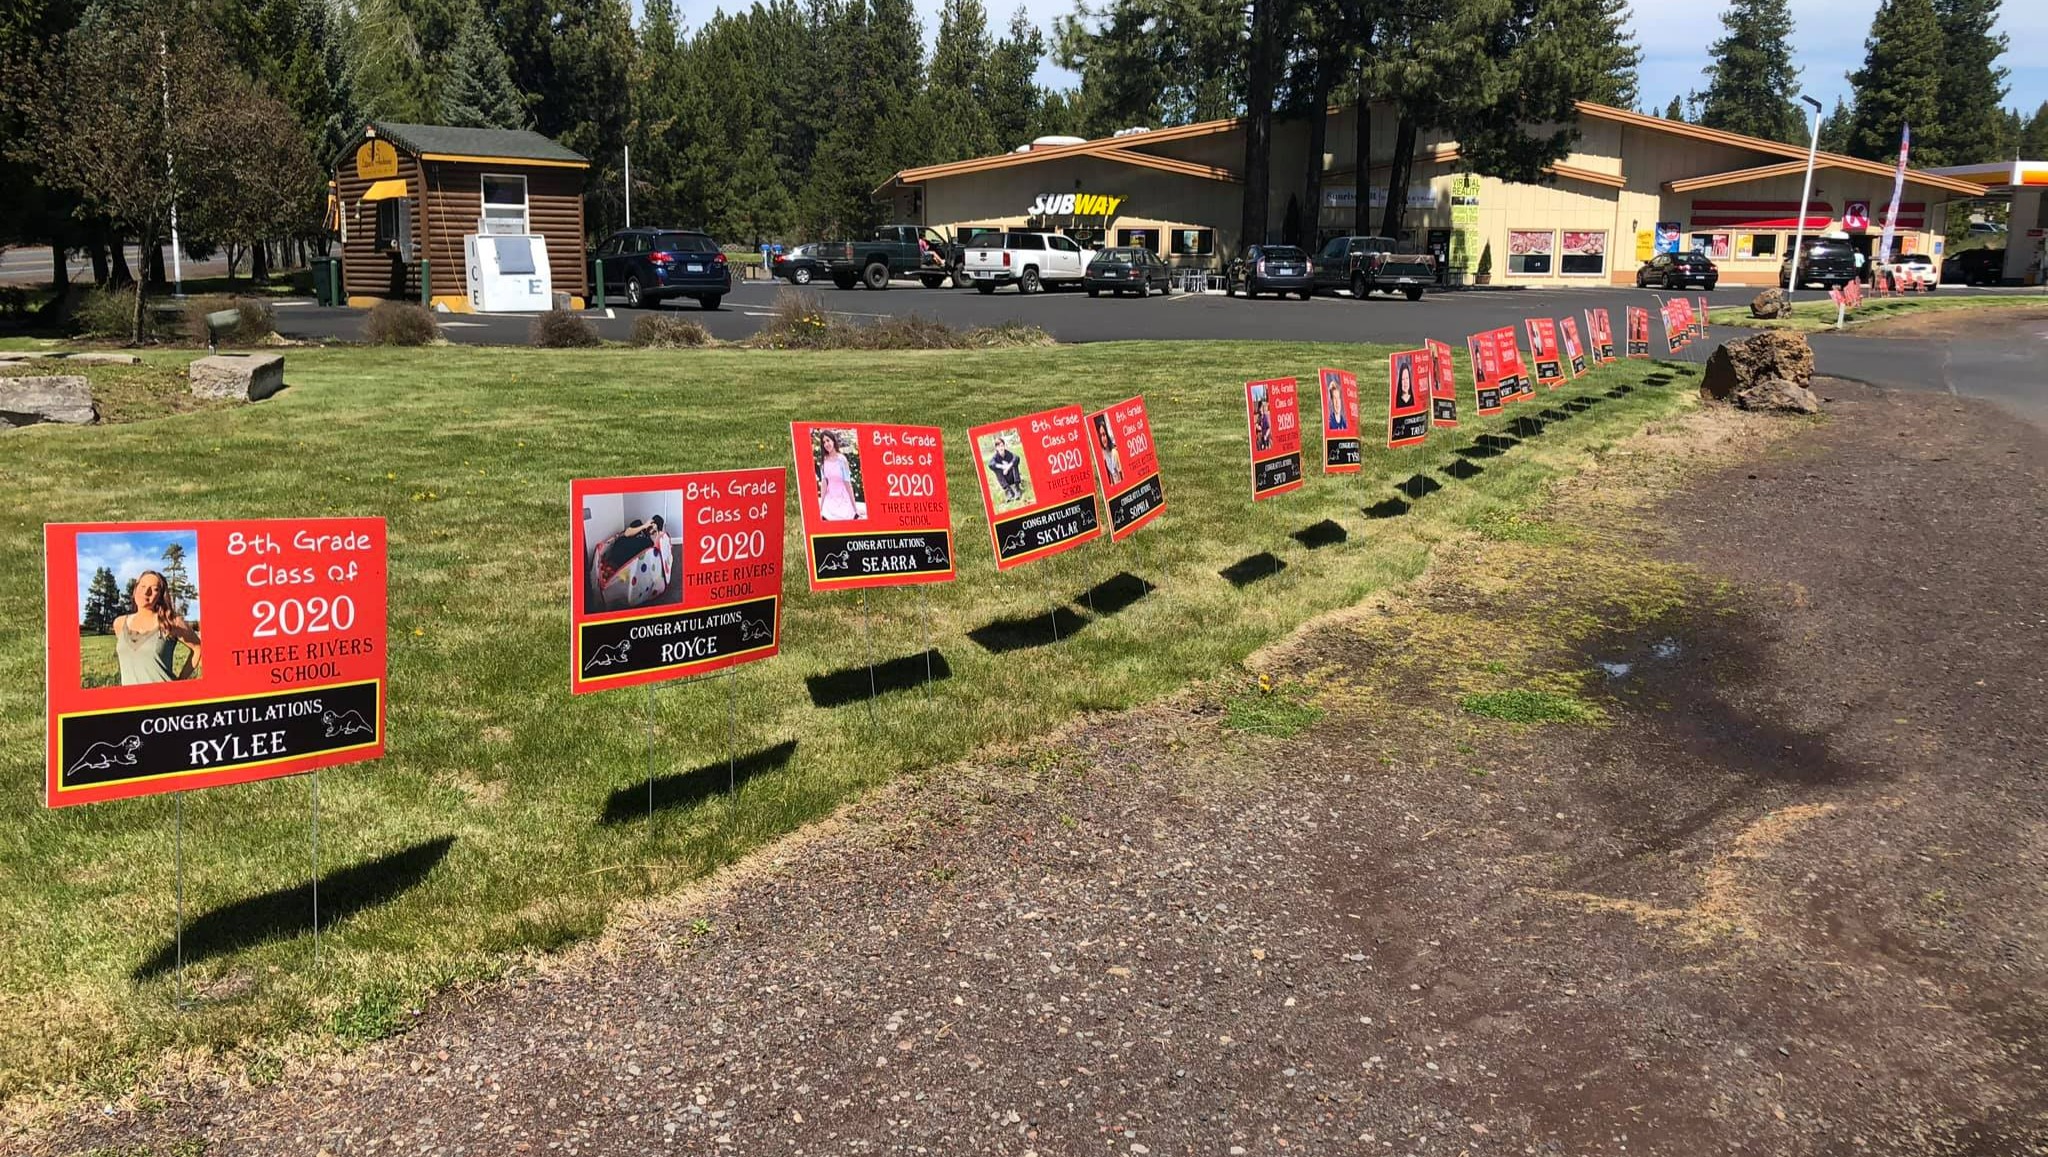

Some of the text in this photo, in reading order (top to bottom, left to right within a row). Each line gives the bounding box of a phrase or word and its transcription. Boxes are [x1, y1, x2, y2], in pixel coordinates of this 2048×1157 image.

[1452, 187, 1480, 195] REALITY
[1028, 193, 1121, 215] SUBWAY
[471, 241, 480, 305] ICE
[1031, 413, 1080, 433] 8th Grade
[1115, 405, 1143, 423] 8th Grade
[1277, 412, 1295, 431] 2020
[872, 430, 937, 447] 8th Grade
[1041, 435, 1066, 448] Class
[1122, 425, 1136, 437] Class
[1127, 433, 1148, 458] 2020
[882, 451, 914, 466] Class
[1048, 447, 1083, 475] 2020
[686, 479, 777, 500] 8th Grade
[887, 473, 934, 497] 2020
[1048, 476, 1070, 491] THREE
[697, 506, 741, 525] Class
[881, 501, 944, 514] THREE RIVERS
[1022, 505, 1081, 530] CONGRATULATIONS
[1129, 504, 1150, 520] SOPHIA
[899, 514, 931, 527] SCHOOL
[227, 530, 372, 555] 8th Grade
[846, 537, 926, 551] CONGRATULATIONS
[1036, 521, 1079, 545] SKYLAR
[700, 529, 765, 564] 2020
[246, 563, 315, 587] Class
[686, 562, 775, 586] THREE RIVERS
[862, 555, 918, 573] SEARRA
[710, 582, 754, 600] SCHOOL
[252, 595, 355, 638] 2020
[630, 611, 743, 639] CONGRATULATIONS
[231, 637, 374, 667] THREE RIVERS
[661, 636, 717, 663] ROYCE
[270, 662, 341, 684] SCHOOL
[140, 699, 324, 736] CONGRATULATIONS
[189, 730, 288, 765] RYLEE
